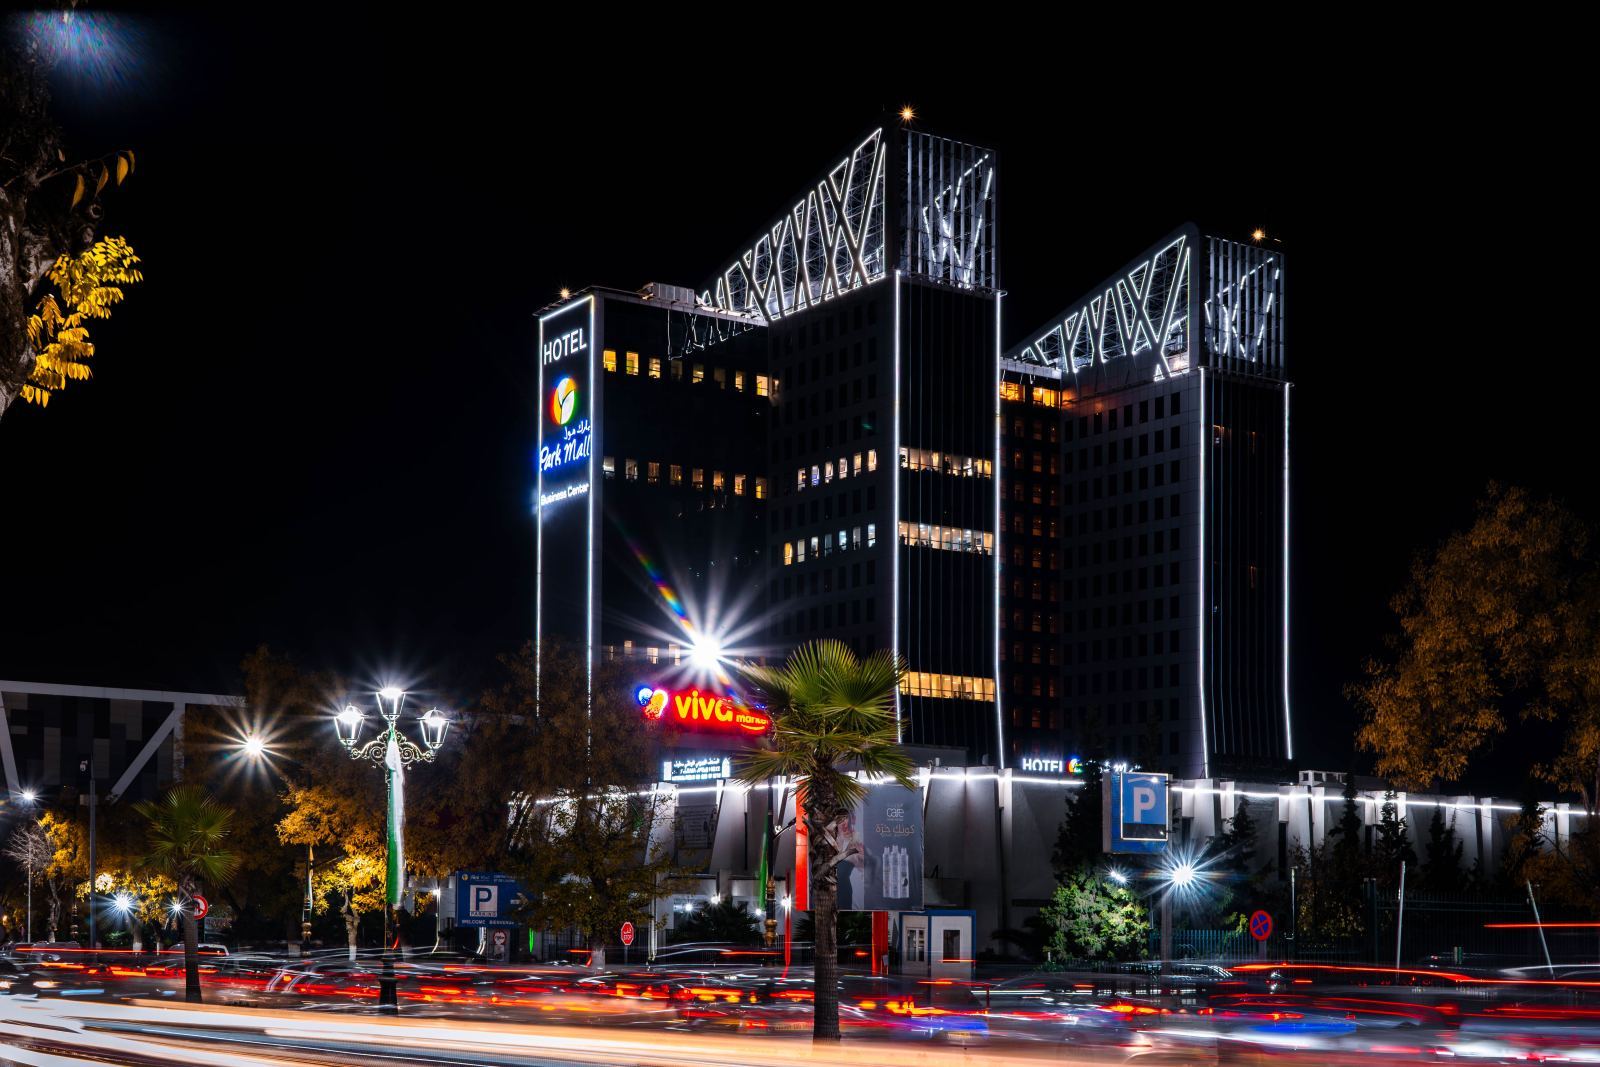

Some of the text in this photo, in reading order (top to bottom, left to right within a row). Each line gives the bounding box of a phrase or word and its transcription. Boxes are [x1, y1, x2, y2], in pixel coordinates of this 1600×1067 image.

[543, 328, 588, 365] HOTEL
[563, 425, 576, 440] مول
[540, 434, 591, 472] Park Mall
[541, 483, 589, 505] Business Center
[675, 690, 733, 722] viva
[1134, 787, 1156, 822] P
[476, 888, 492, 911] P
